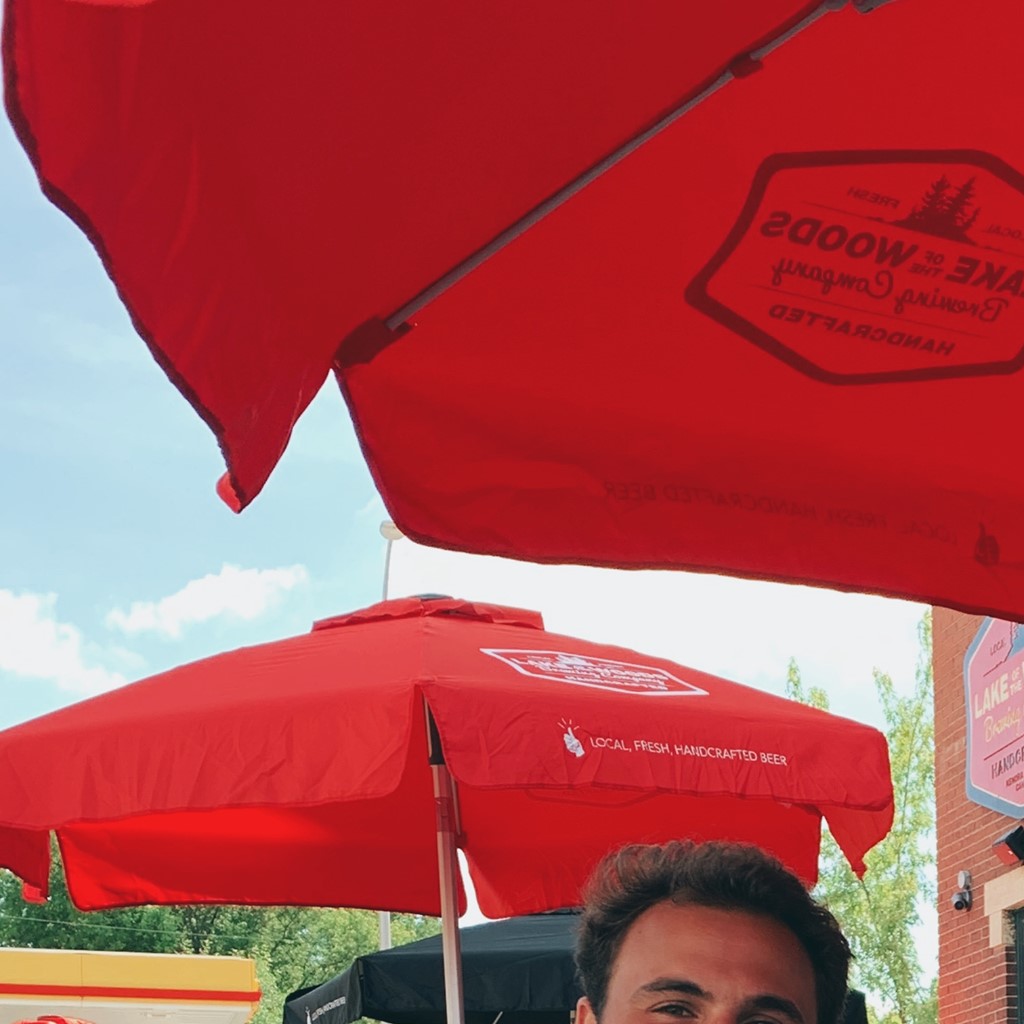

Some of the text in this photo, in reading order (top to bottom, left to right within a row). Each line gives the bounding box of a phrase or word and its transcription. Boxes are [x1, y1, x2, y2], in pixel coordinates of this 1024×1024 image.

[974, 672, 1010, 719] LAKE
[589, 736, 788, 766] LOCAL, FRESH, HANDCRAFTED BEER
